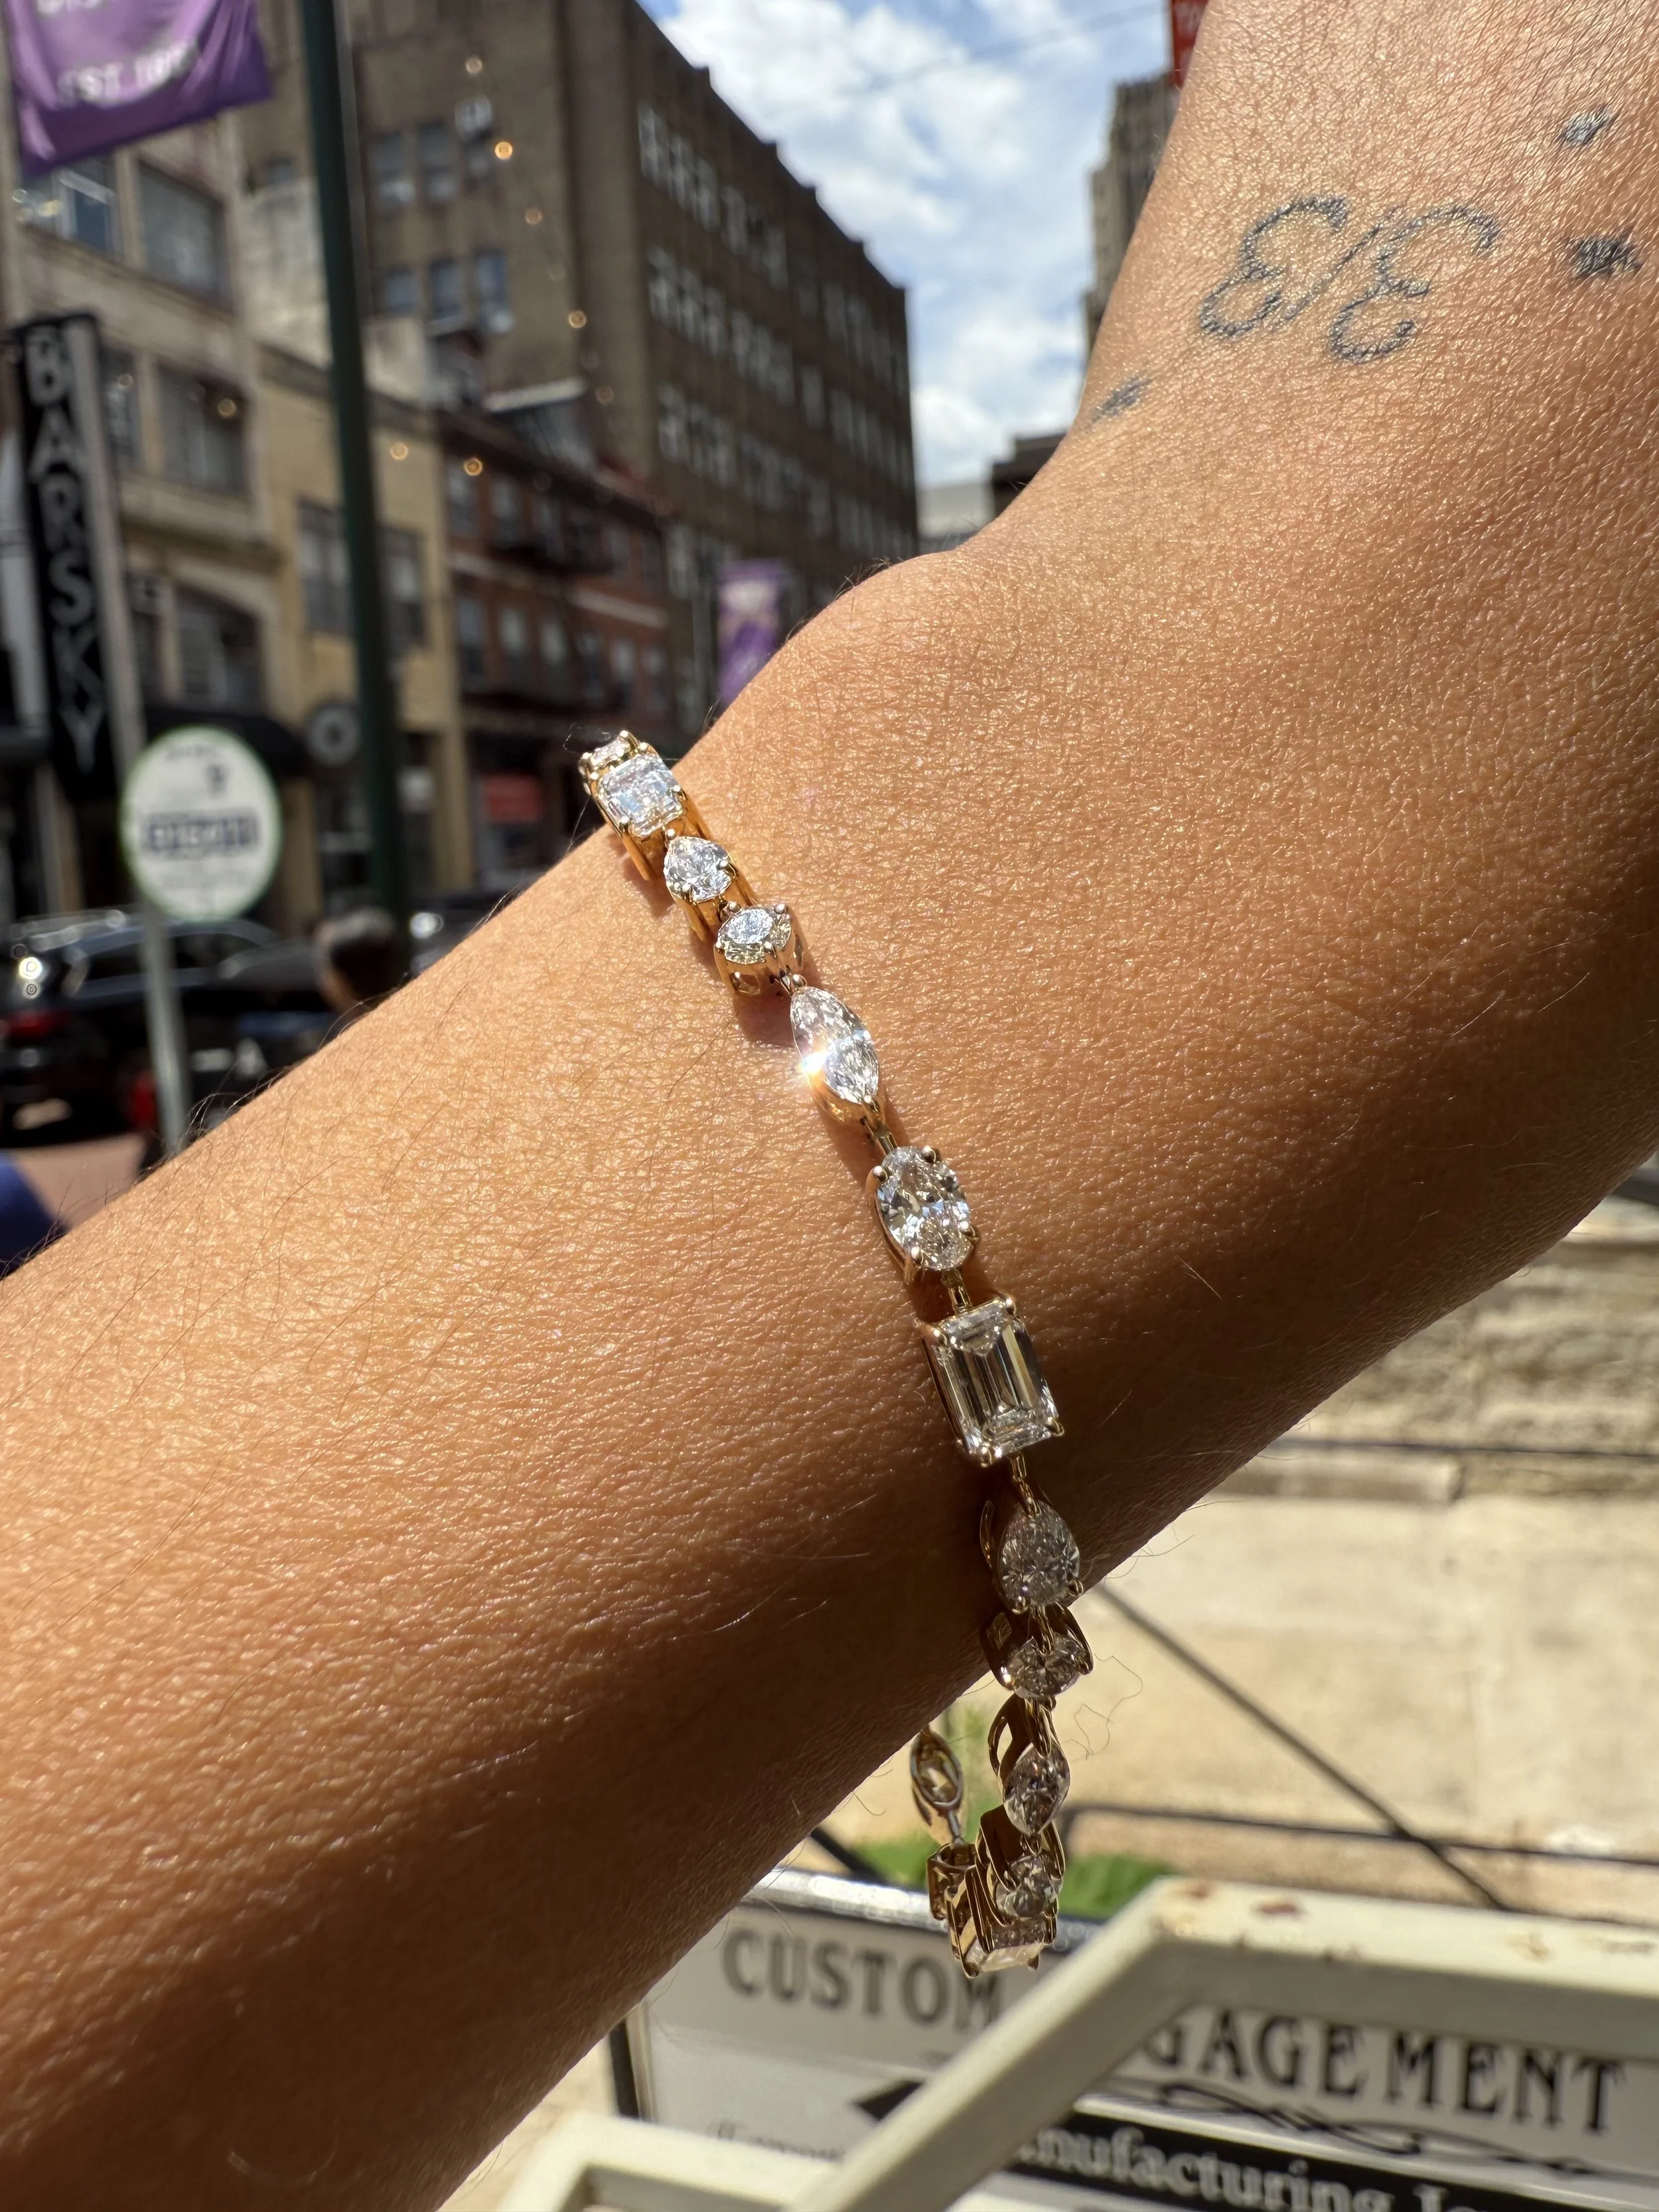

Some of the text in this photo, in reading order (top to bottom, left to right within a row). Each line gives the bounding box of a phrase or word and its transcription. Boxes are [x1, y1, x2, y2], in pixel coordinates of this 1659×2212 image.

[24, 325, 103, 774] BARSKY
[722, 1927, 1626, 2134] CUSTOM GAGEMENT
[1018, 2126, 1395, 2212] nufacturin
